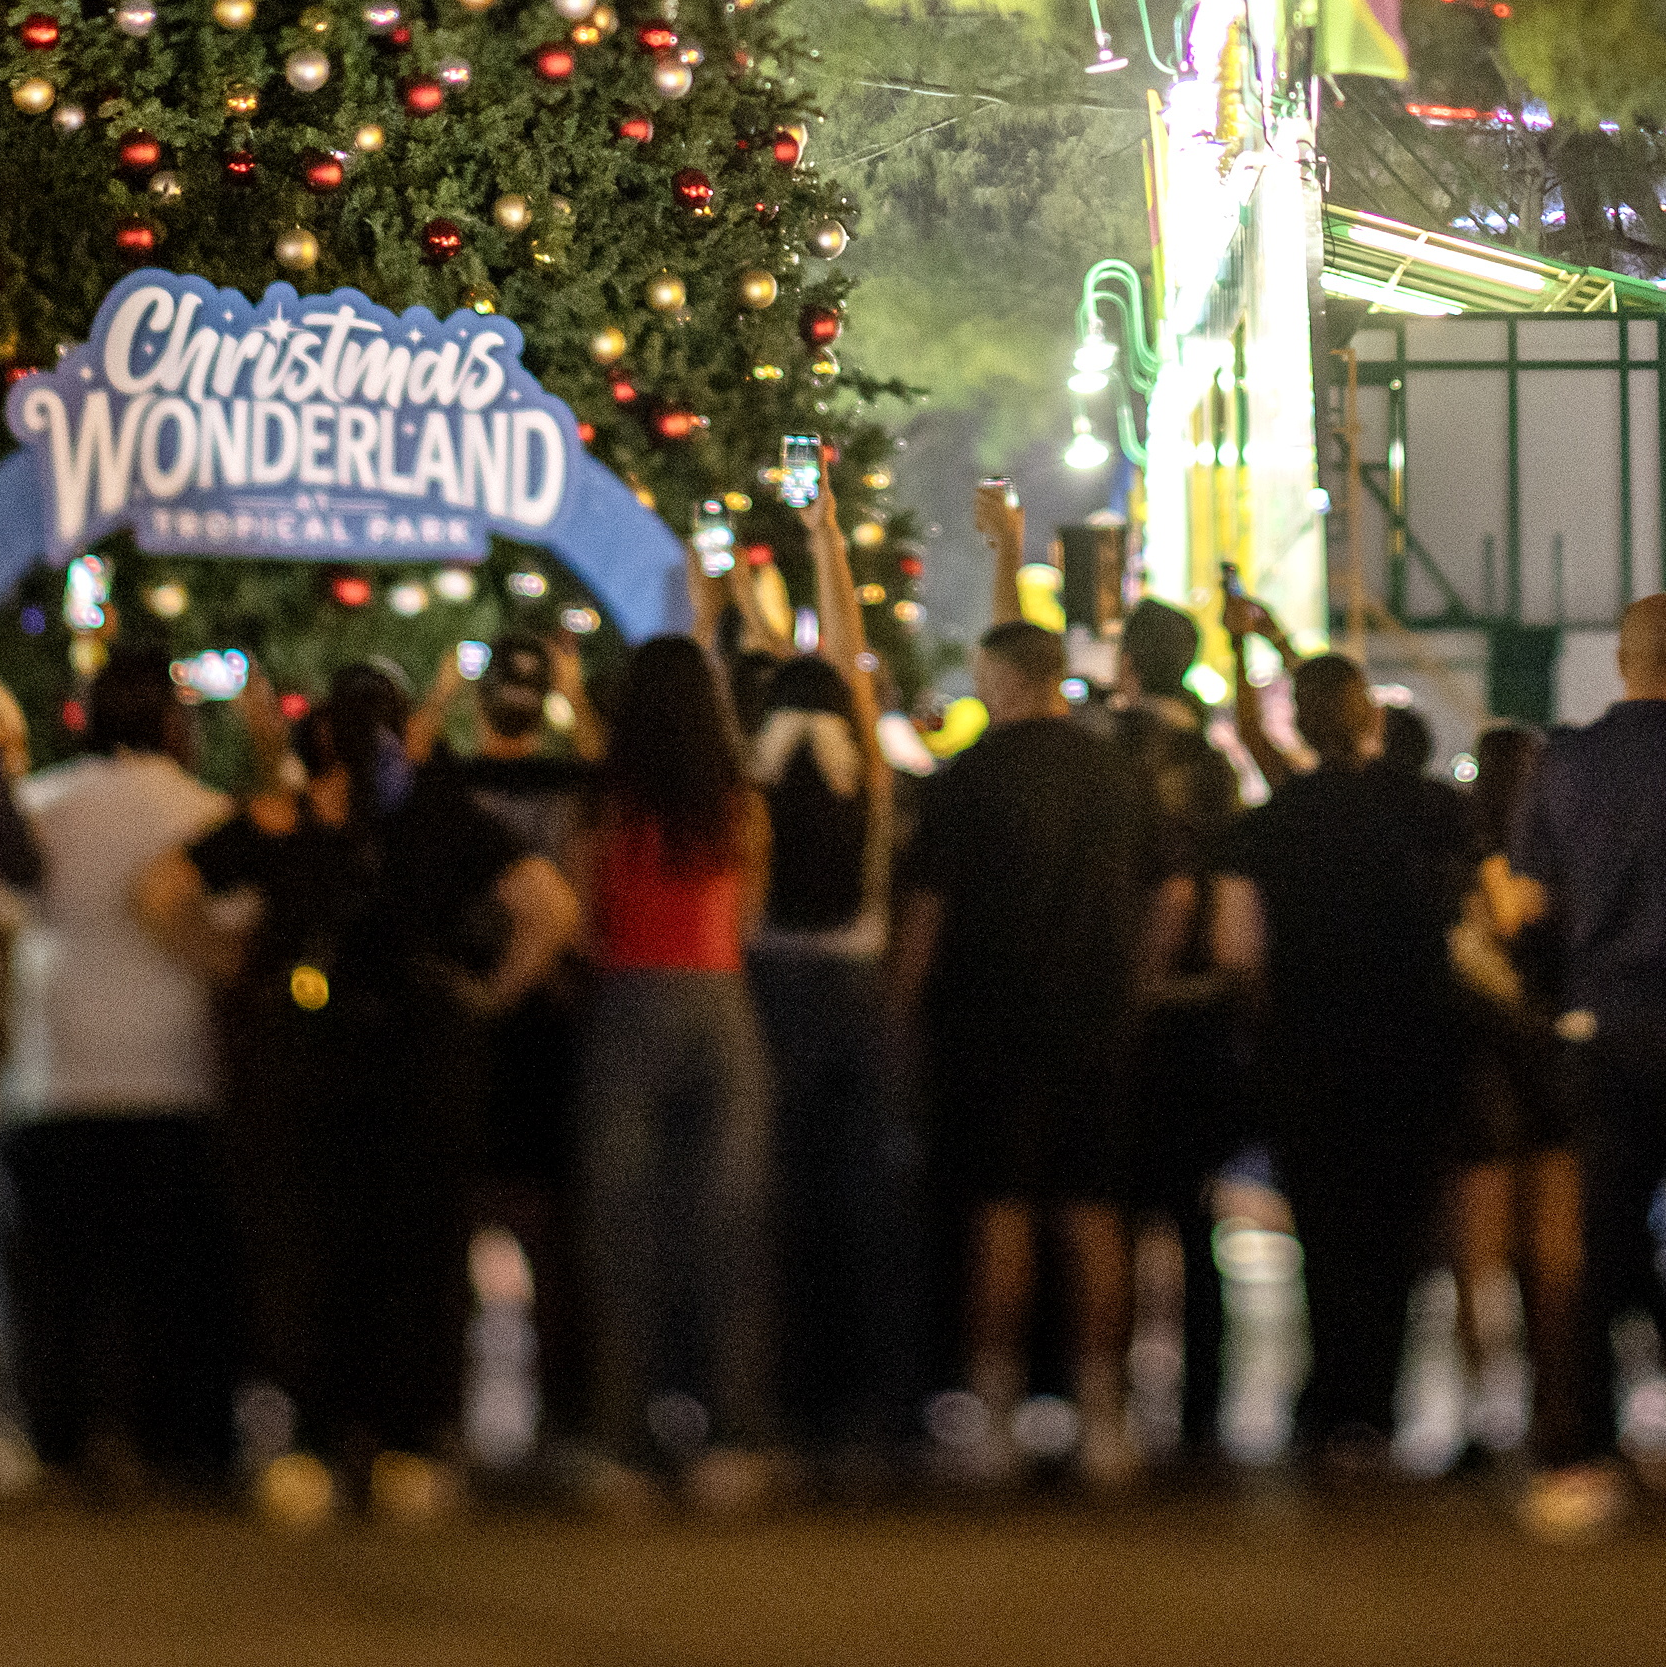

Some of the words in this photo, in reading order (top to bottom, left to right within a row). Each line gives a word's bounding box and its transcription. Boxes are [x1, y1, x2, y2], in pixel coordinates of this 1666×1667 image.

[103, 284, 506, 412] Christmas
[23, 387, 566, 542] WONDERLAND
[152, 507, 350, 544] TROPICAL
[368, 514, 472, 544] PARK
